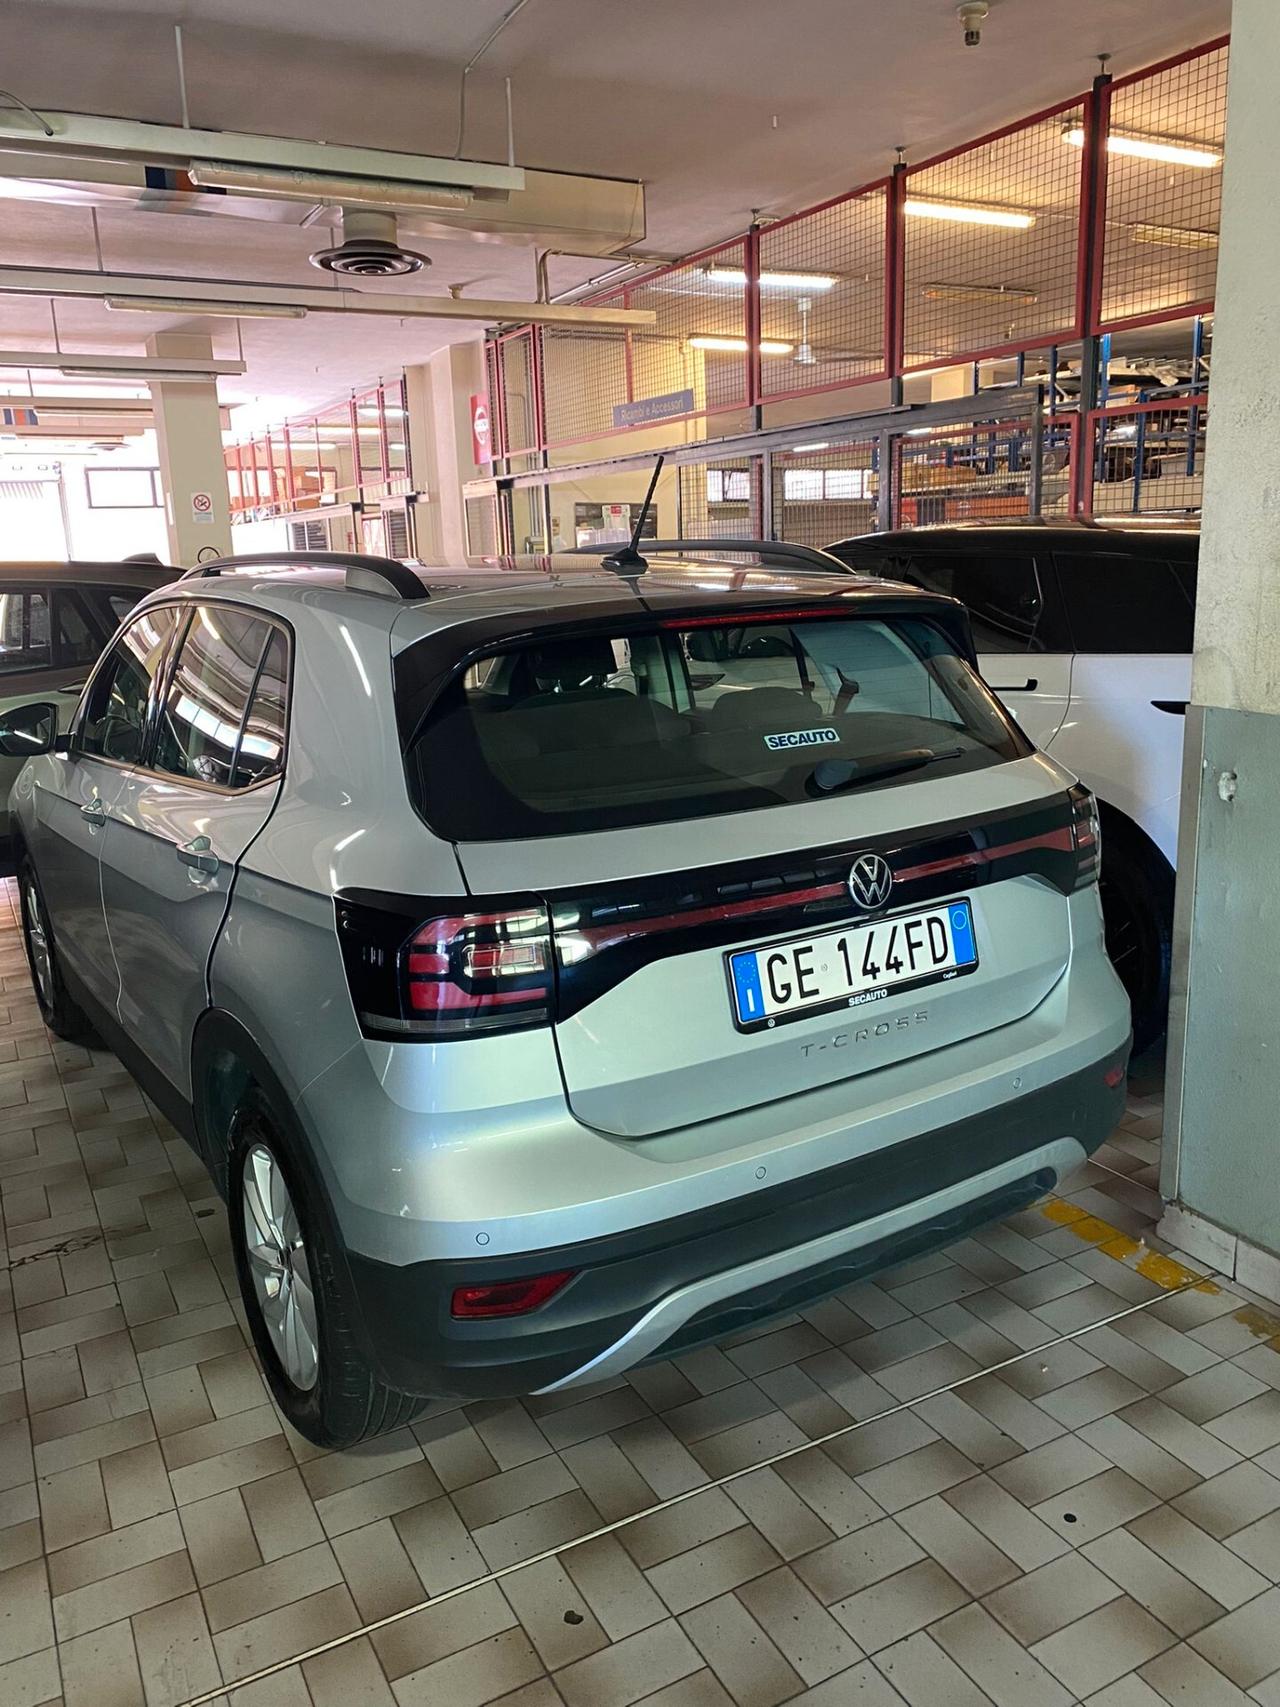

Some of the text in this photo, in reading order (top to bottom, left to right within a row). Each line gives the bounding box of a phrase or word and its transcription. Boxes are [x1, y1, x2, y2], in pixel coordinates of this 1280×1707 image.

[768, 730, 836, 748] SECAUTO
[766, 916, 949, 1004] GE 144FD
[848, 989, 887, 1006] SECAUTO
[801, 1010, 928, 1056] T-CROSS
